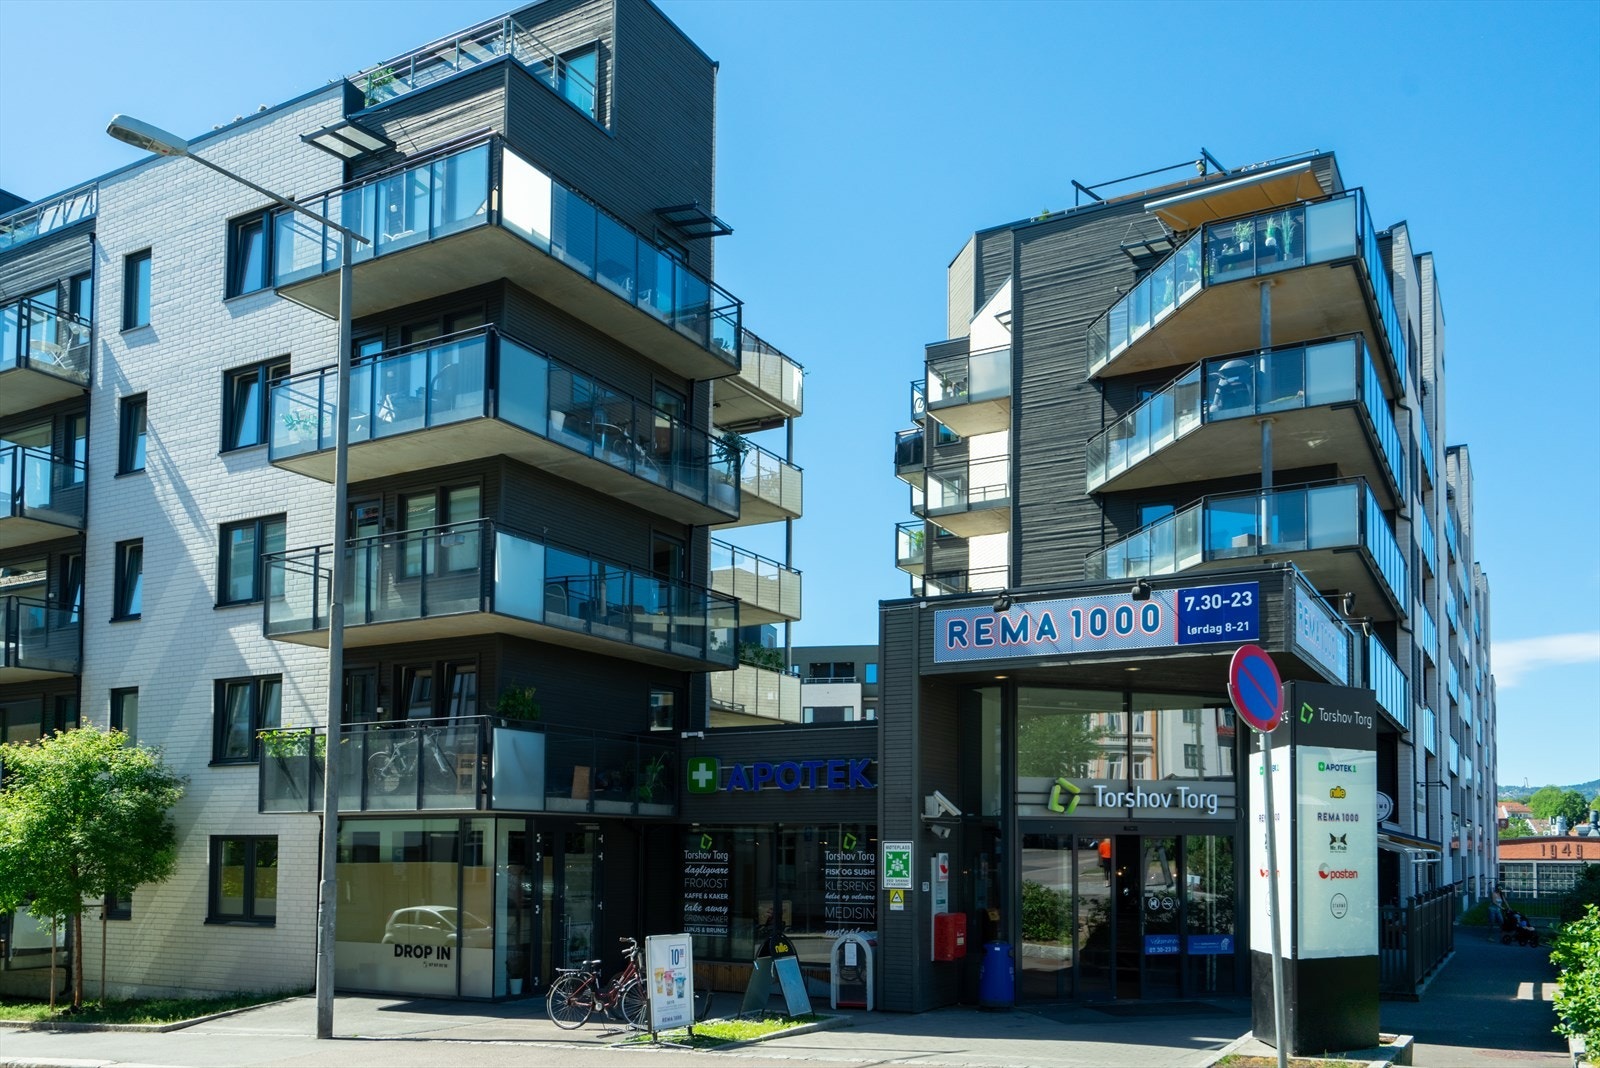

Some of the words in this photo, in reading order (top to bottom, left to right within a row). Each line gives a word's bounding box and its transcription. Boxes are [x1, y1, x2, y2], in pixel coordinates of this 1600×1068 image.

[1184, 591, 1253, 613] 7.30-23
[946, 609, 1060, 650] REMA
[1069, 601, 1164, 641] 1000
[1186, 622, 1222, 638] lørdag
[1224, 621, 1250, 633] 8-21
[1318, 707, 1352, 724] Torshov
[1353, 711, 1373, 729] Torg
[726, 757, 874, 792] APOTEK
[1093, 784, 1172, 809] Torshov
[1176, 786, 1218, 815] Torg
[1317, 812, 1340, 822] REMA
[1341, 812, 1359, 822] 1000
[684, 850, 711, 860] Torshov
[712, 850, 729, 862] Torg
[824, 850, 856, 861] Torshov
[857, 851, 875, 863] Torg
[684, 865, 728, 876] dagligvare
[841, 868, 852, 876] OG
[1330, 868, 1358, 880] posten
[684, 878, 728, 888] FROKOST
[825, 881, 876, 892] KLESRENS
[684, 902, 703, 912] take
[704, 905, 729, 915] away
[825, 906, 875, 920] MEDISIN
[684, 914, 729, 923] GRØNNSAKER
[394, 943, 433, 959] DROP
[436, 946, 451, 960] IN
